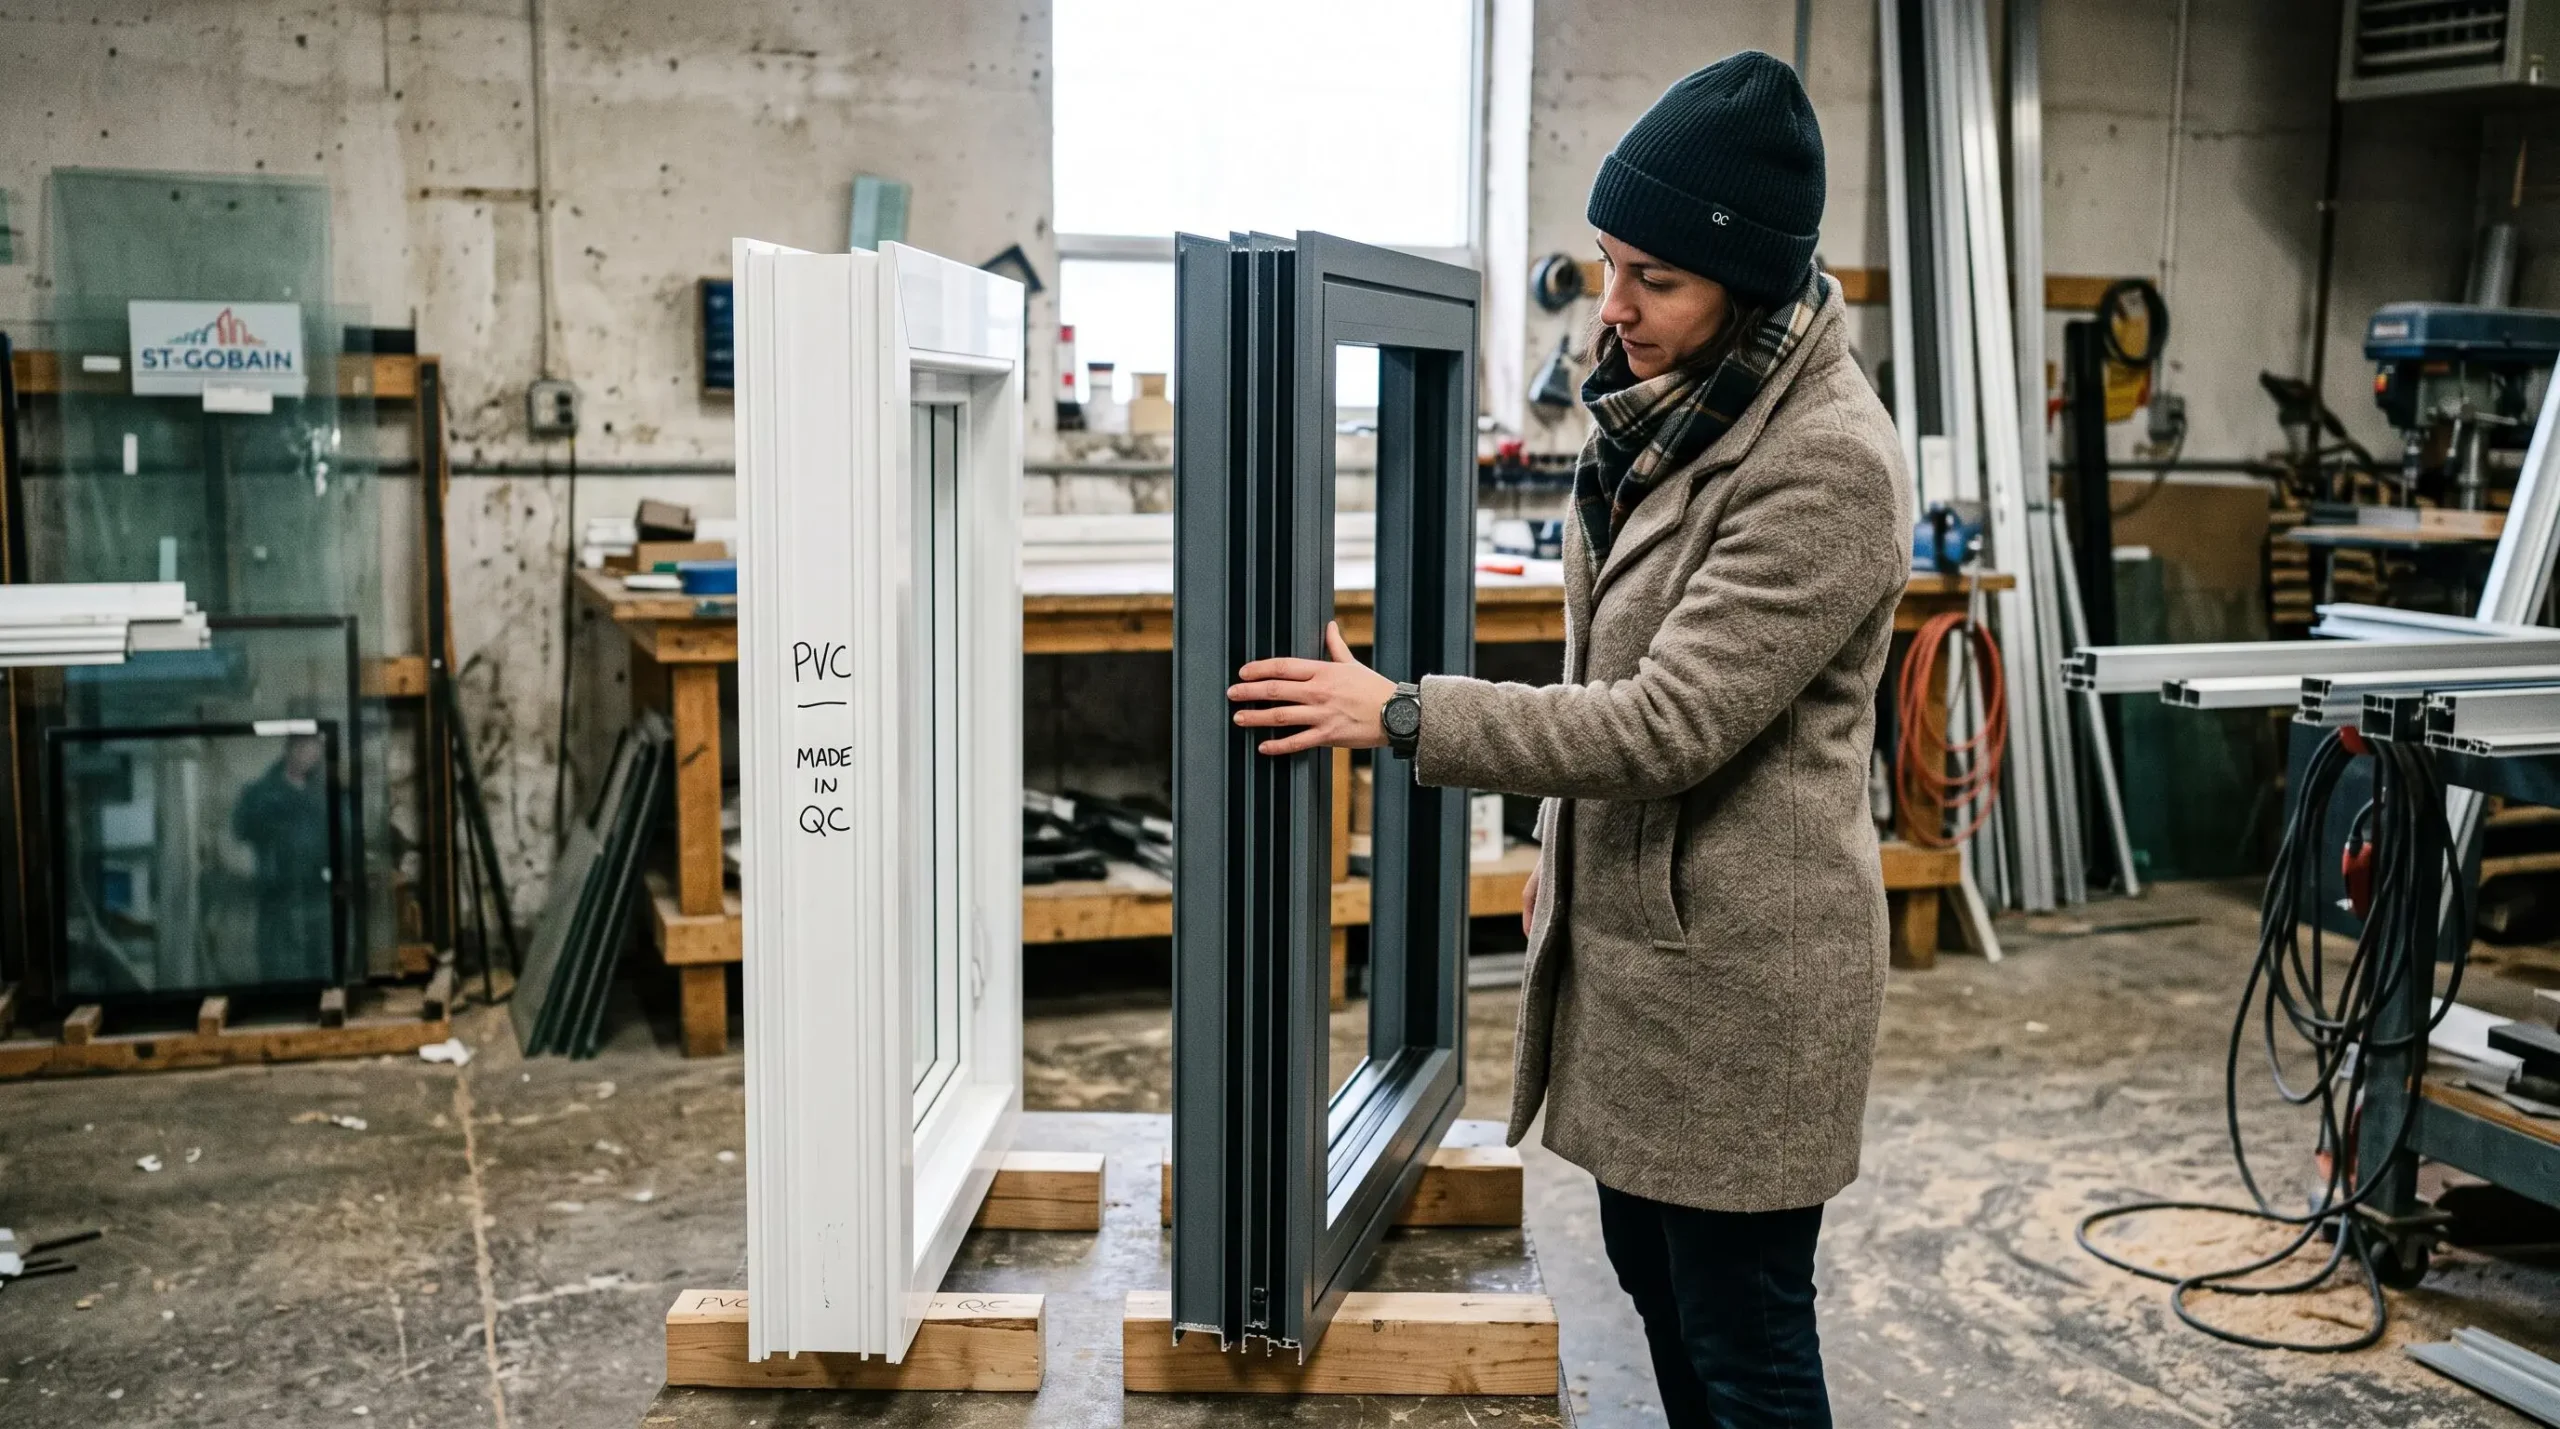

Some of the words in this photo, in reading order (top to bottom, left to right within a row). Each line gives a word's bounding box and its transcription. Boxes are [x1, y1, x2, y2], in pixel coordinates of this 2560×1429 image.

[1712, 211, 1729, 226] QC
[793, 641, 851, 682] PVC
[797, 746, 852, 768] MADE
[814, 777, 837, 794] IN
[799, 805, 850, 837] QC
